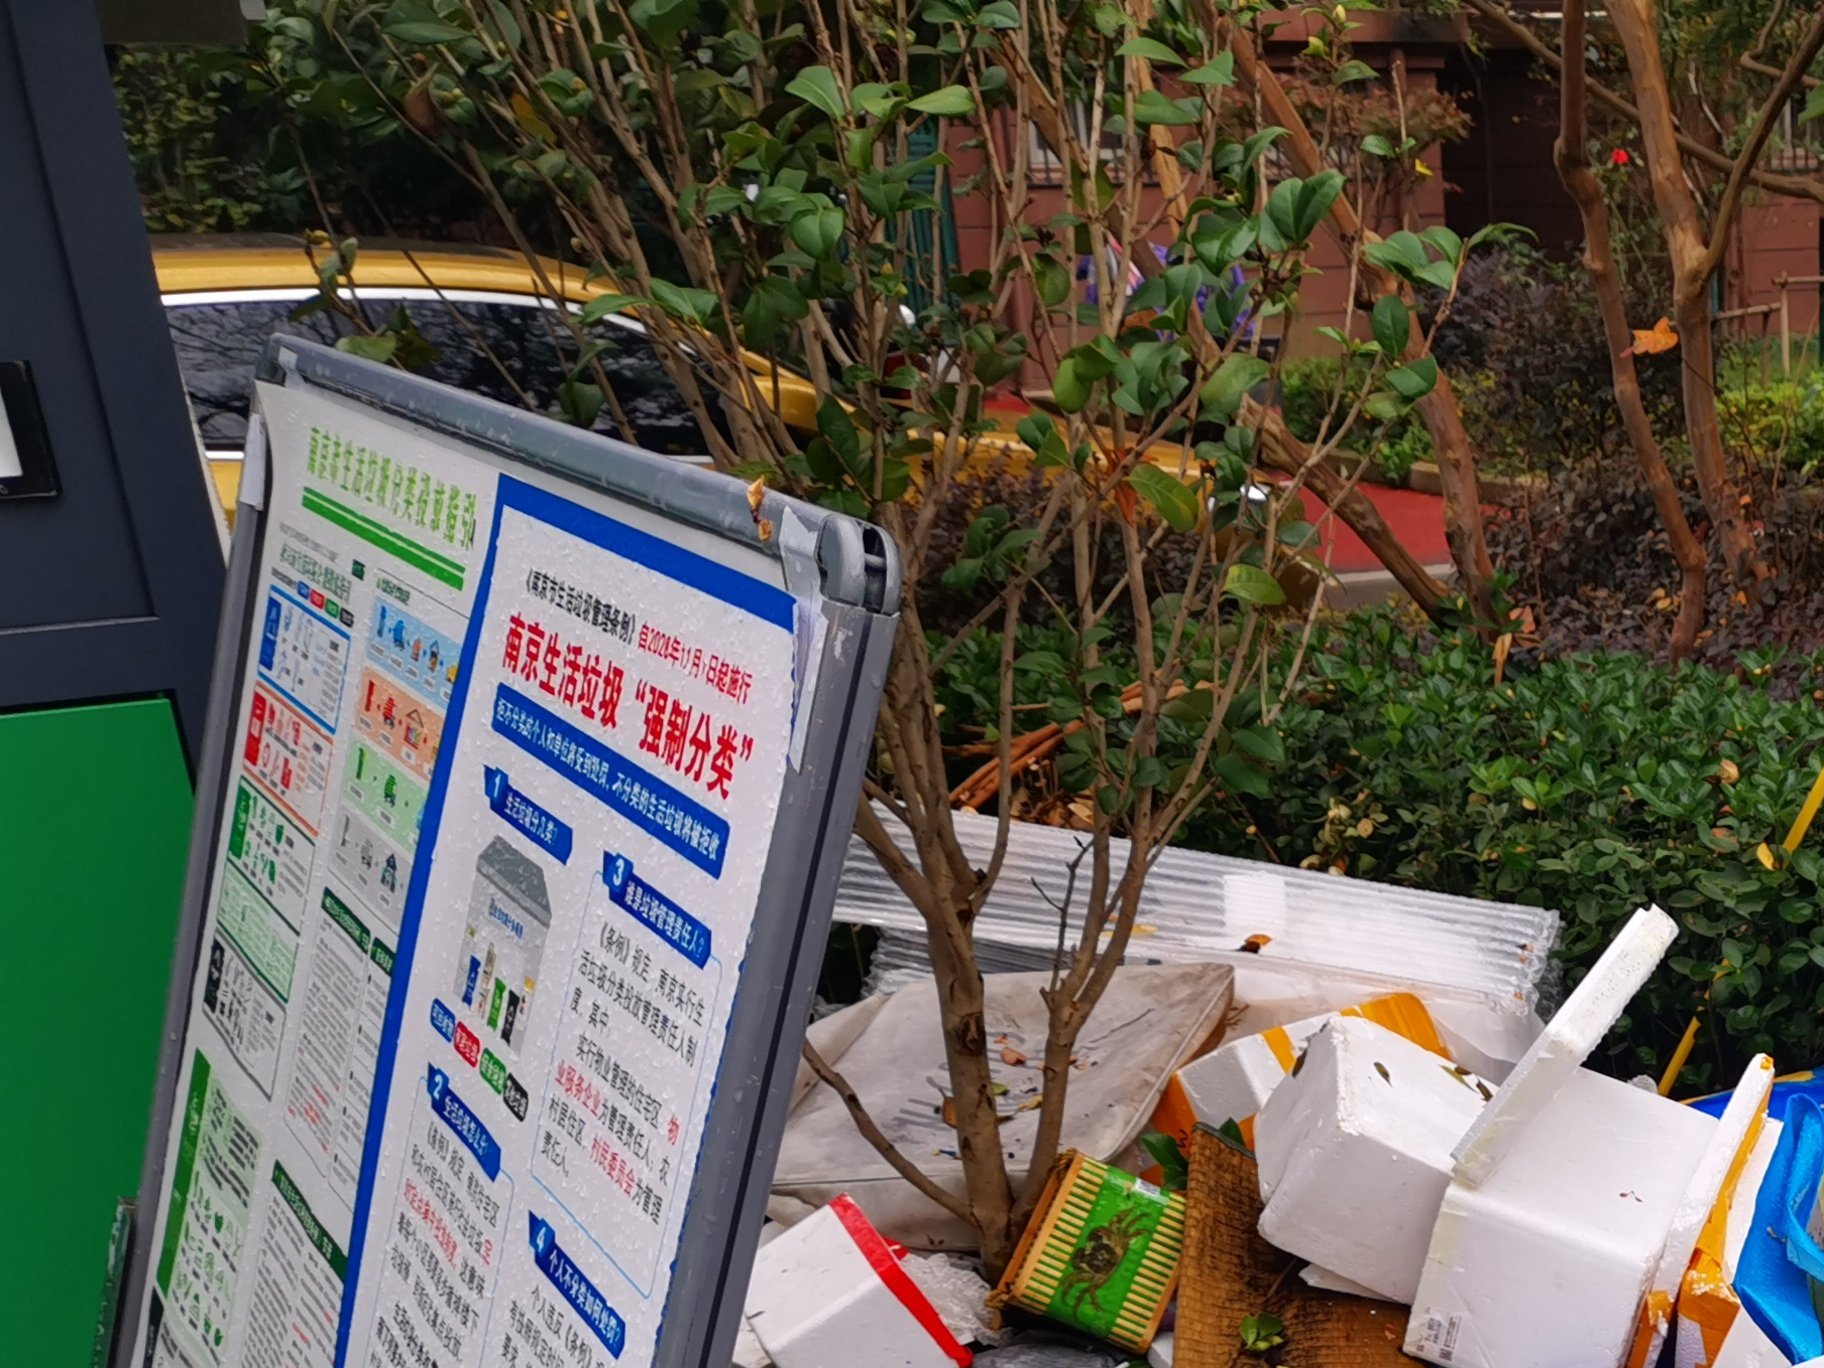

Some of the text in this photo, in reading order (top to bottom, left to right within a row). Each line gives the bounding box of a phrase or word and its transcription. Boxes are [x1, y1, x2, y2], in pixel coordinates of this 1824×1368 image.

[501, 609, 754, 801] 南京生活垃圾“强制分类”
[492, 772, 501, 797] 1
[611, 856, 625, 888] 3
[577, 947, 698, 1069] 活垃圾分类投放管理责任人制
[431, 1072, 443, 1100] 2
[535, 1224, 546, 1253] 4
